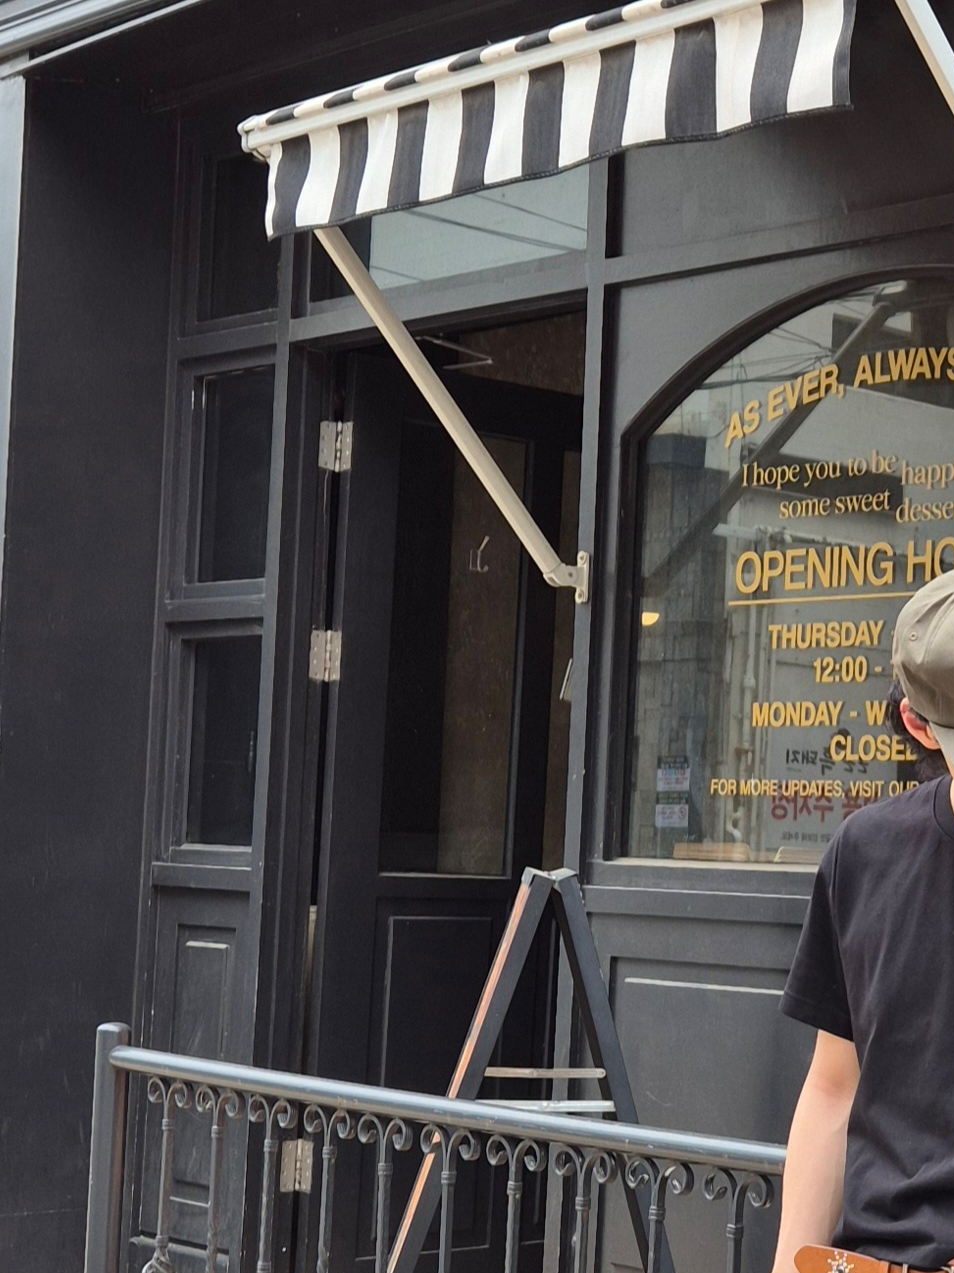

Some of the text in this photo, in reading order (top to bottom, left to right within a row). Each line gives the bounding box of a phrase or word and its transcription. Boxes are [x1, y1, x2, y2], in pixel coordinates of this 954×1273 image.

[725, 400, 761, 449] AS
[768, 364, 846, 421] EVER,
[741, 463, 749, 487] I
[752, 461, 800, 491] hope
[803, 461, 842, 488] you
[848, 457, 867, 477] to
[872, 449, 897, 474] be
[779, 497, 830, 519] some
[835, 488, 891, 514] sweet
[735, 542, 894, 594] OPENING
[768, 620, 884, 650] THURSDAY
[813, 656, 868, 683] 12:00
[752, 701, 843, 728] MONDAY
[710, 779, 737, 796] FOR
[740, 779, 778, 796] MORE
[782, 779, 845, 799] UPDATES,
[850, 780, 884, 797] VISIT
